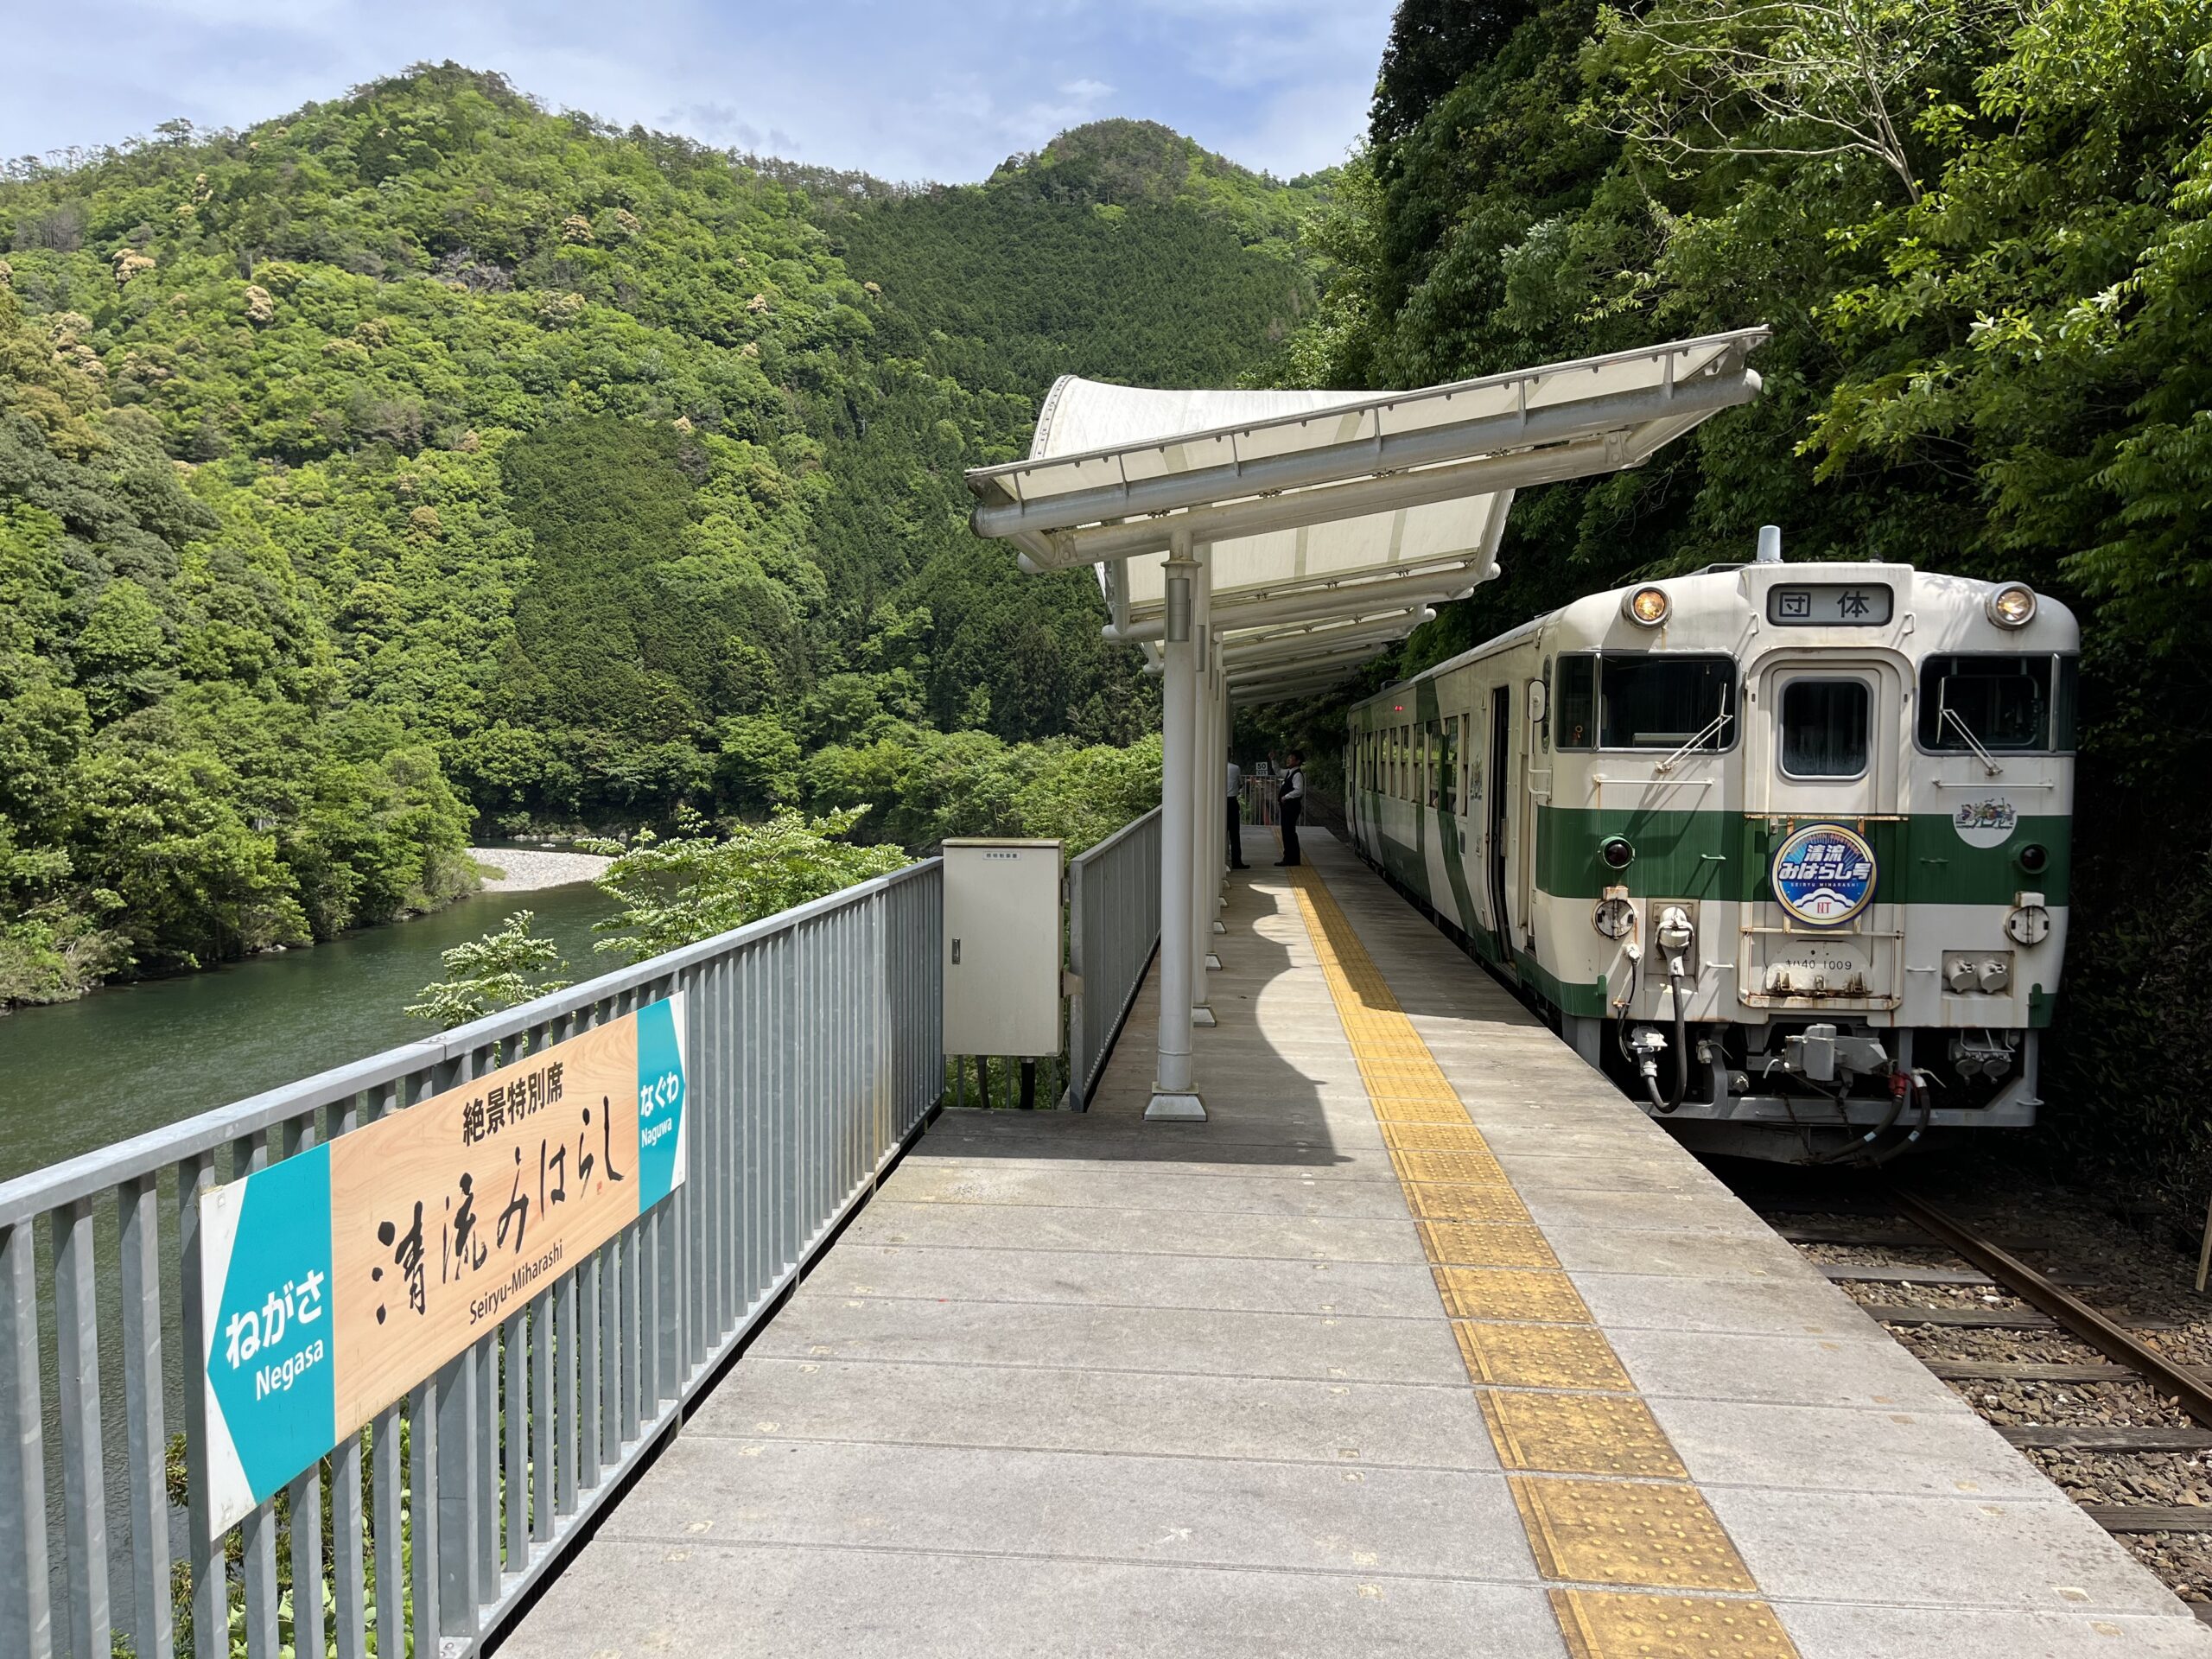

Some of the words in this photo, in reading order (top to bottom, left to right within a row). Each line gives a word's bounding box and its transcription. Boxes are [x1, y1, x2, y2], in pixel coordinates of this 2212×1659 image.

[1779, 590, 1870, 618] 団体
[1779, 862, 1872, 880] みはらし号
[1804, 844, 1845, 861] 清流
[1823, 960, 1852, 969] 1009
[462, 1061, 563, 1147] 絶景特別席
[640, 1071, 679, 1117] なぐわ
[641, 1117, 672, 1148] Naguwa
[470, 1239, 563, 1325] Seiryu-Miharashi
[226, 1269, 325, 1370] ねがさ
[256, 1338, 324, 1402] Negasa
